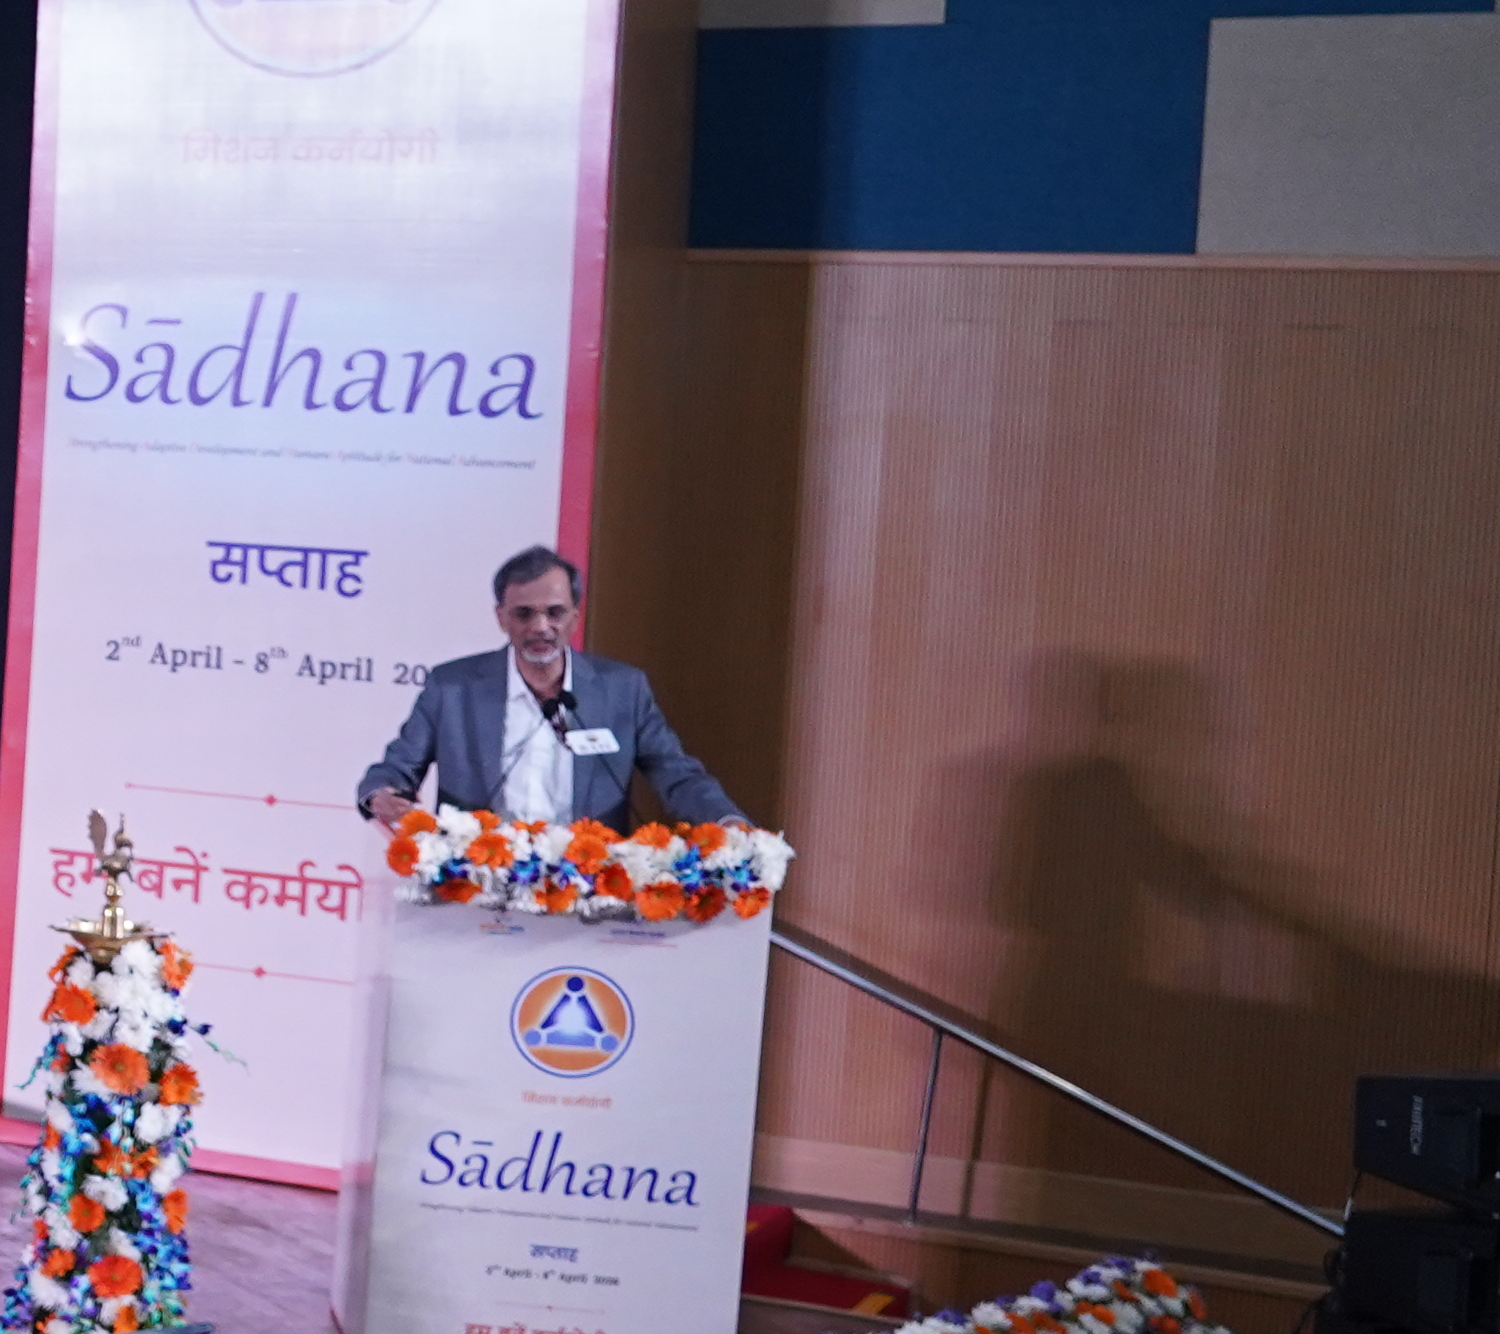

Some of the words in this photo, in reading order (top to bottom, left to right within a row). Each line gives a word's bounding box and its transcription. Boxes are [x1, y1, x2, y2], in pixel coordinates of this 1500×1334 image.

[62, 290, 544, 421] Sādhana
[205, 538, 370, 598] सप्ताह
[148, 641, 224, 673] April
[295, 652, 375, 685] April
[391, 662, 430, 687] 20
[133, 845, 210, 903] बनें
[419, 1129, 700, 1207] Sādhana
